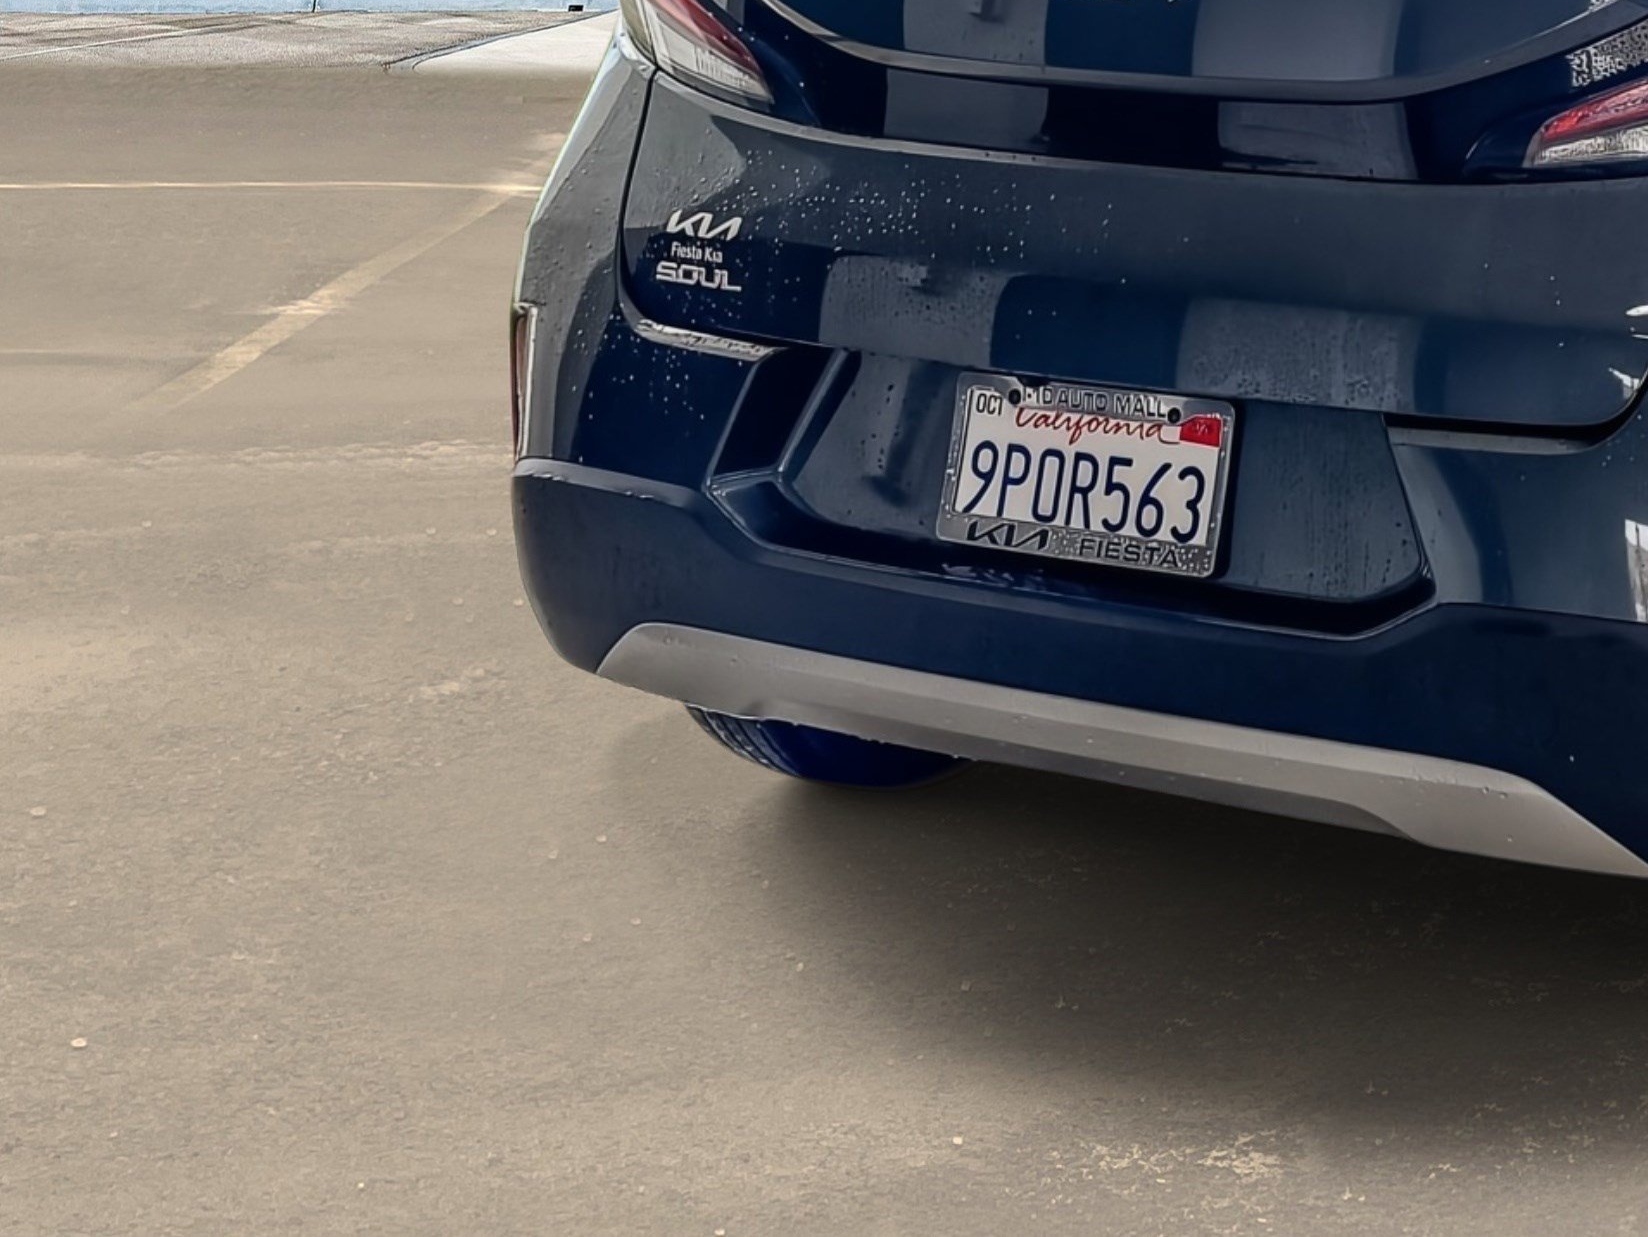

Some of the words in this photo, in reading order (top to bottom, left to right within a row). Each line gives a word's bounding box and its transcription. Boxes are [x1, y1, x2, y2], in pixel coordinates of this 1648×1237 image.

[666, 209, 743, 242] KIA
[671, 241, 702, 260] Fiesta
[704, 246, 723, 263] Kia
[656, 260, 742, 292] SOUL
[976, 393, 1003, 416] OCT
[1056, 389, 1108, 412] AUTO
[1113, 395, 1167, 419] MALL
[1015, 407, 1180, 445] California
[966, 520, 1049, 550] KIA
[1079, 537, 1181, 567] FIESTA
